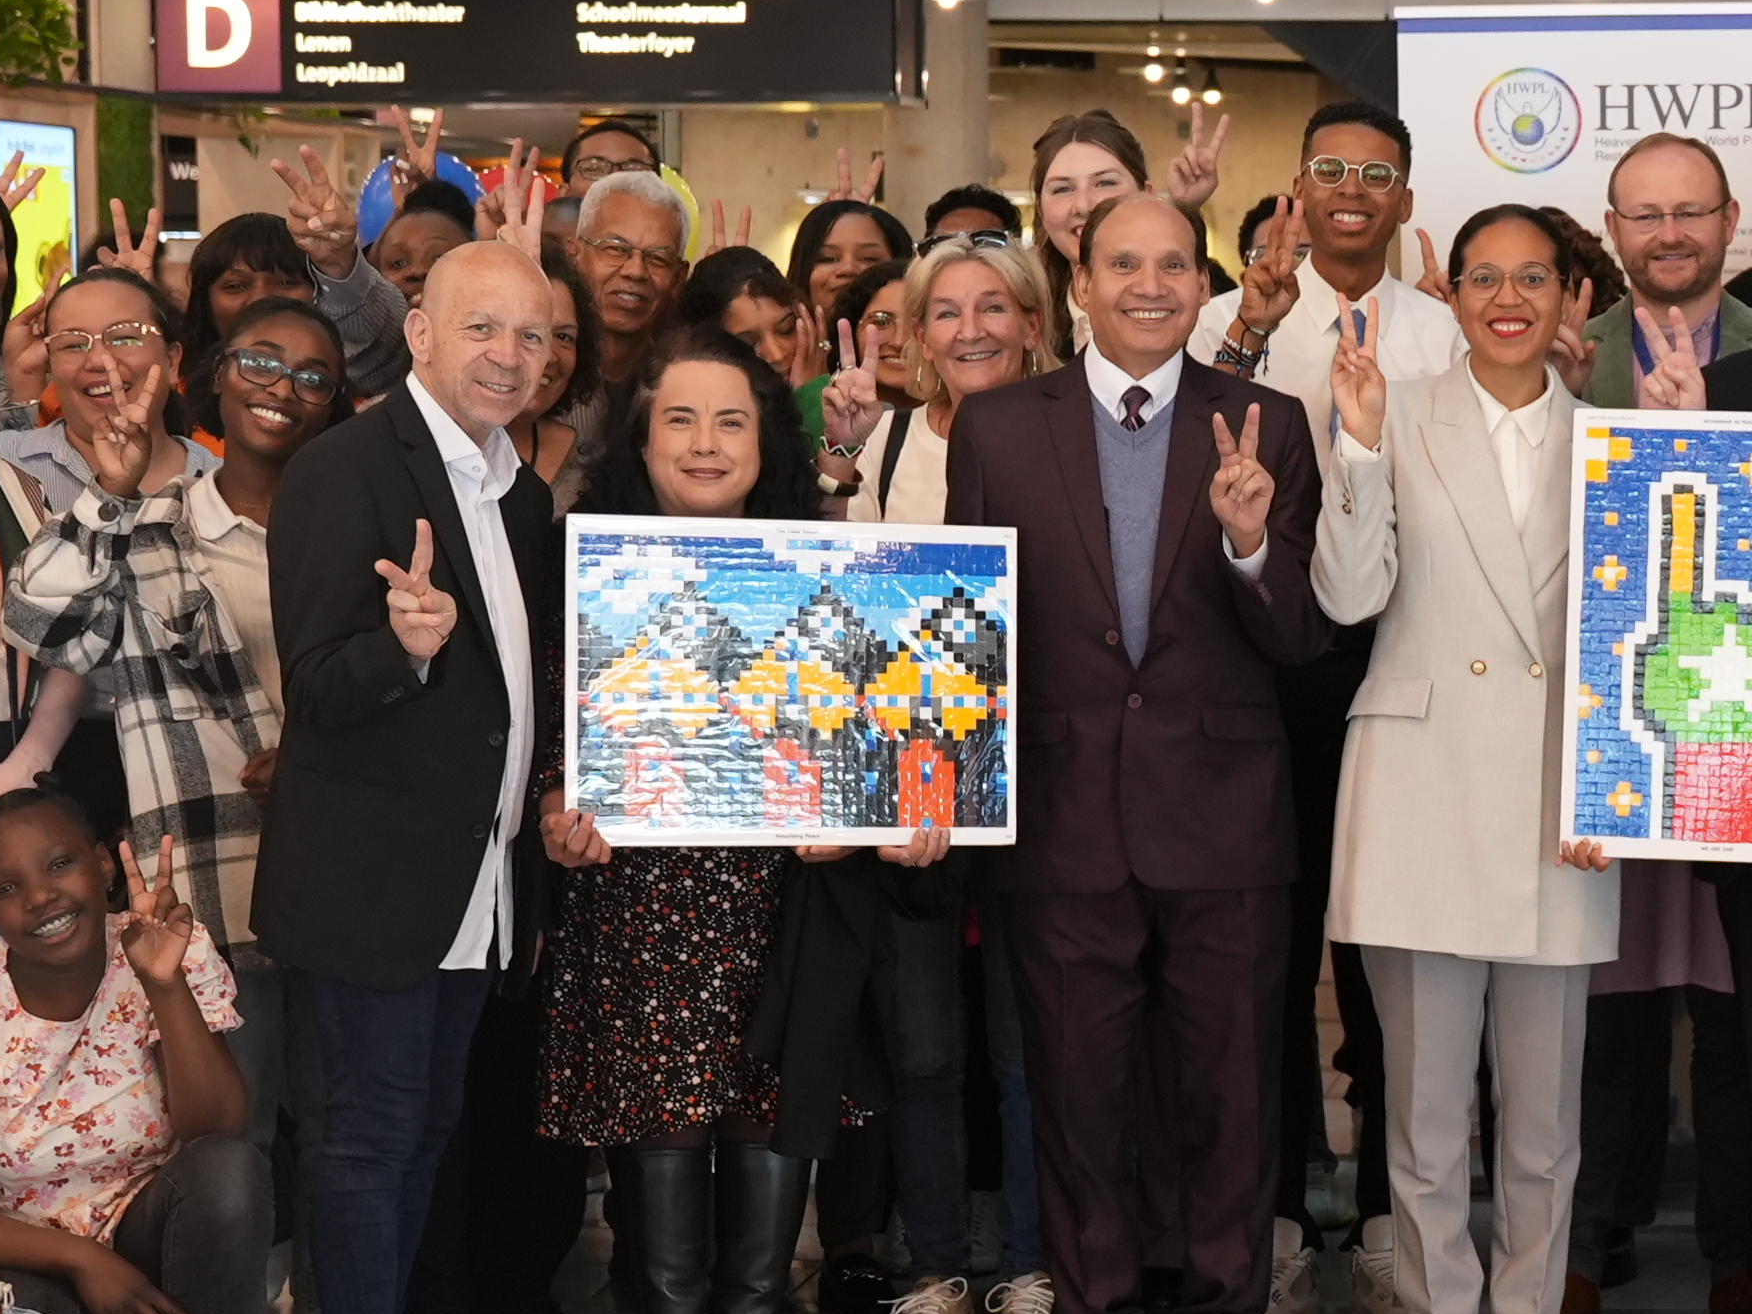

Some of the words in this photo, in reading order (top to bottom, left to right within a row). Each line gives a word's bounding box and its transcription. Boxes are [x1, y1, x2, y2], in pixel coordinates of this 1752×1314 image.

[296, 33, 351, 52] Lenen
[576, 32, 695, 57] Theaterfoyer
[296, 62, 404, 86] Leopoldzaal
[1506, 82, 1550, 96] HWPL
[1594, 137, 1636, 148] Heave
[1705, 135, 1739, 146] World
